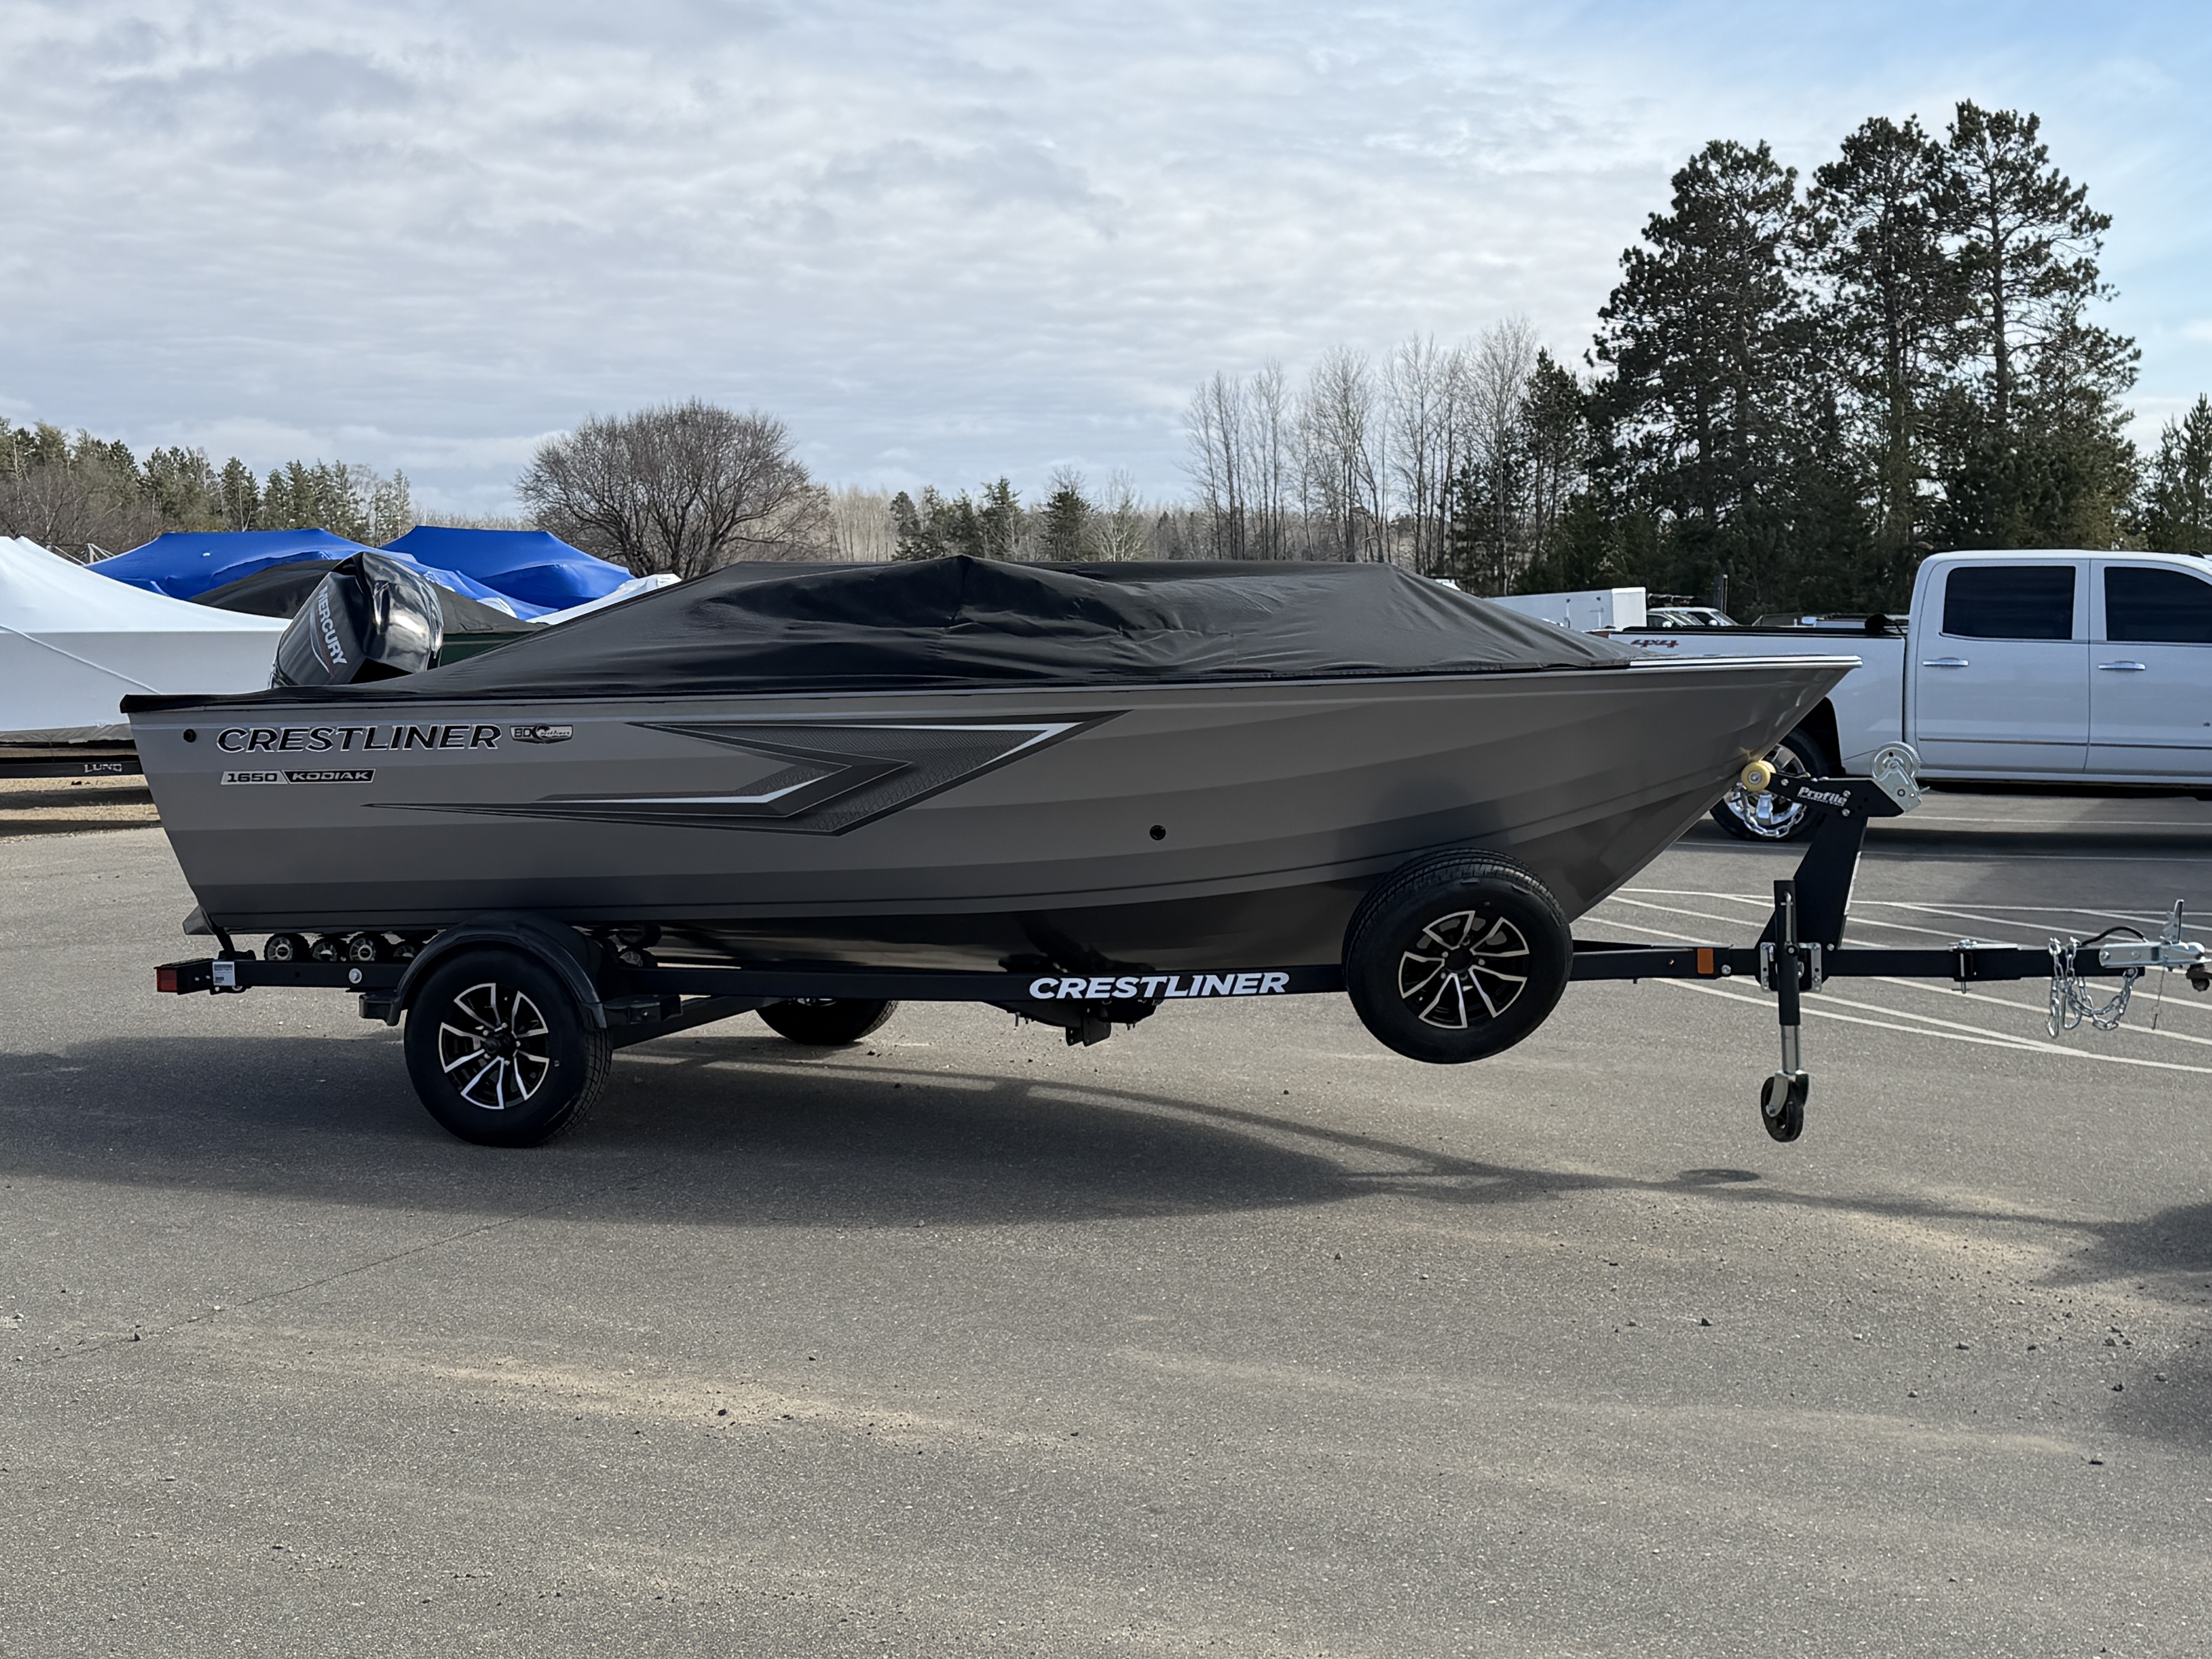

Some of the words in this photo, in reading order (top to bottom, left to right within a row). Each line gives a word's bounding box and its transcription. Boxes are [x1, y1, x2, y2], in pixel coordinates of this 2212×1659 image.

[318, 586, 347, 664] MERCURY
[217, 723, 501, 753] CRESTLINER
[84, 764, 122, 773] LUND
[227, 773, 277, 782] 1650
[292, 771, 369, 780] KODIAK
[1797, 787, 1847, 806] Profile
[1029, 972, 1290, 999] CRESTLINER
